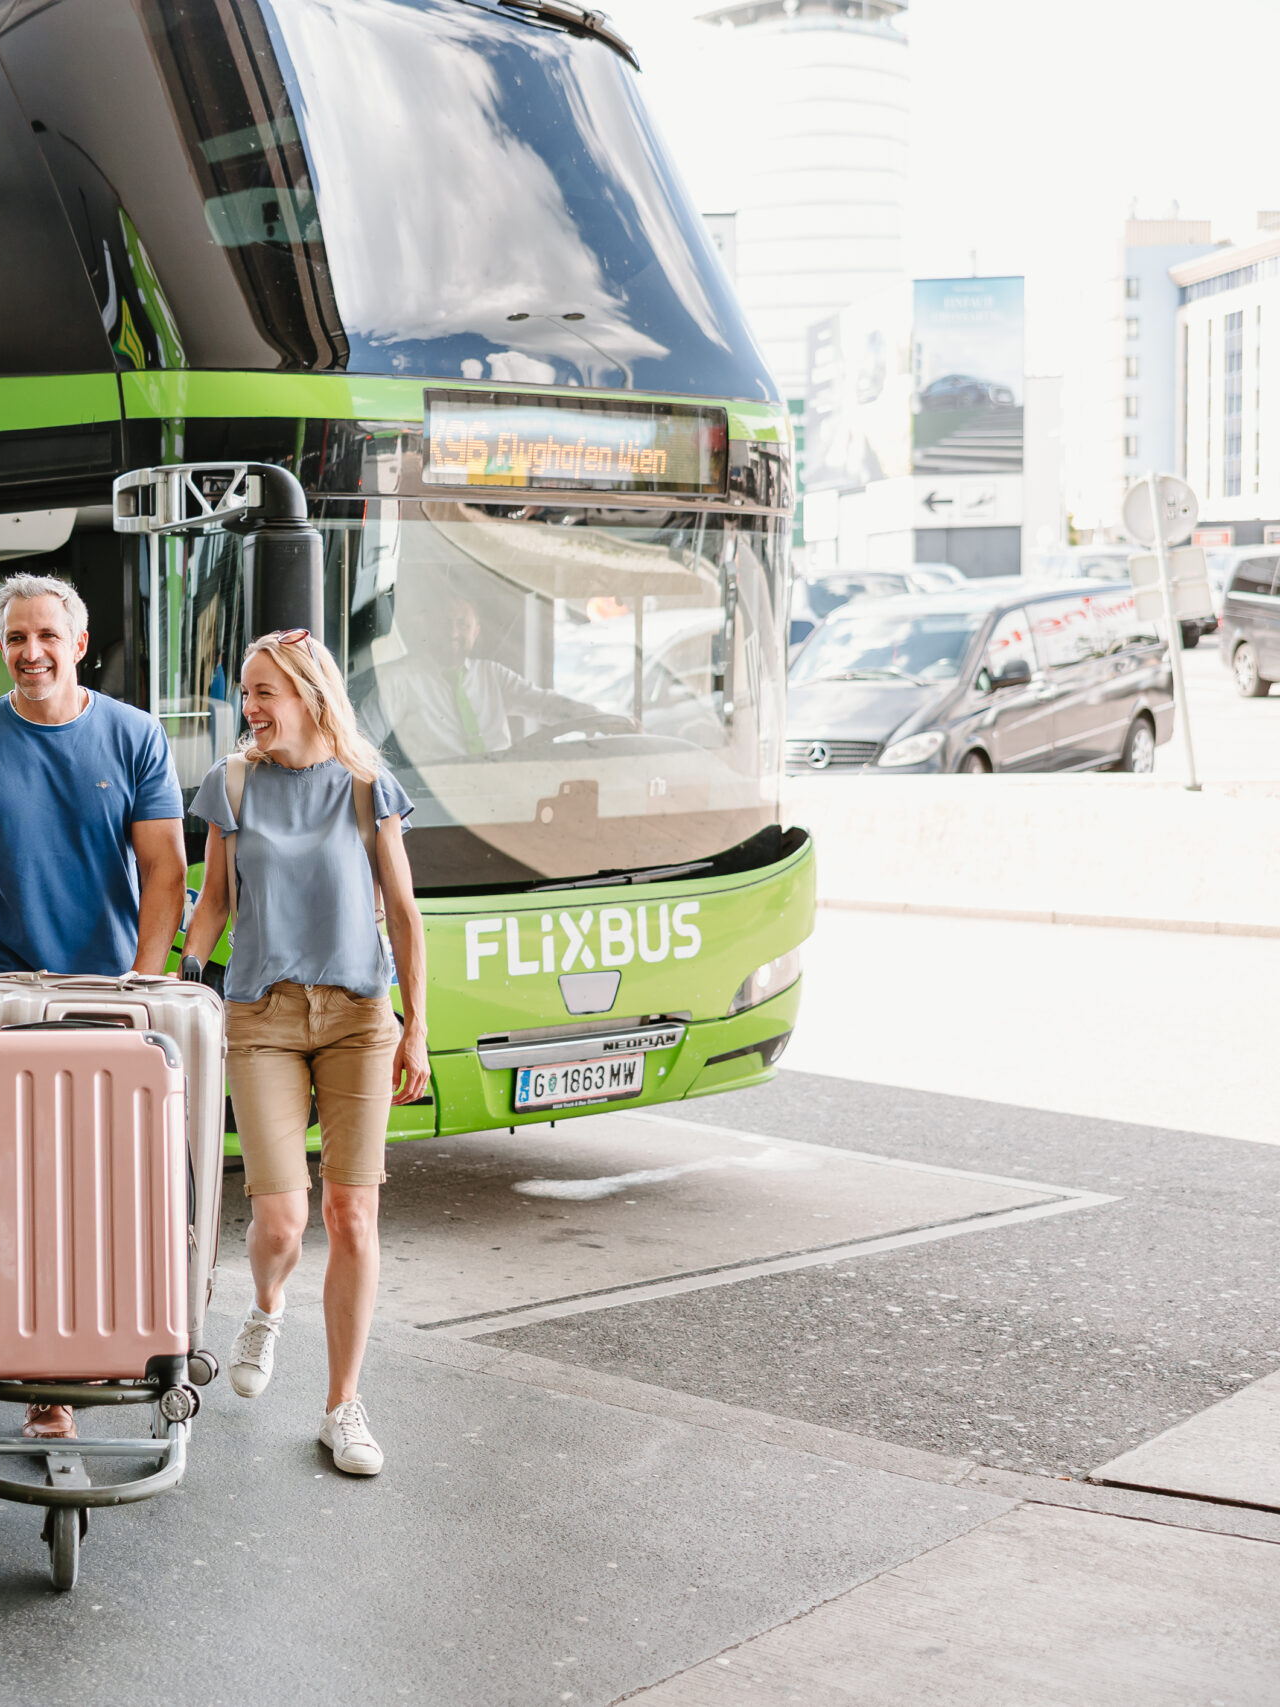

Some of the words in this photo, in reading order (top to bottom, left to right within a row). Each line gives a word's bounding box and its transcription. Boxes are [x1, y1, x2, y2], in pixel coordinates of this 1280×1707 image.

[496, 431, 612, 479] Flughafen
[618, 438, 667, 475] Wien
[603, 1034, 677, 1050] NEOPLAN
[534, 1073, 545, 1098] G
[561, 1065, 605, 1094] 1863
[609, 1060, 637, 1088] MW
